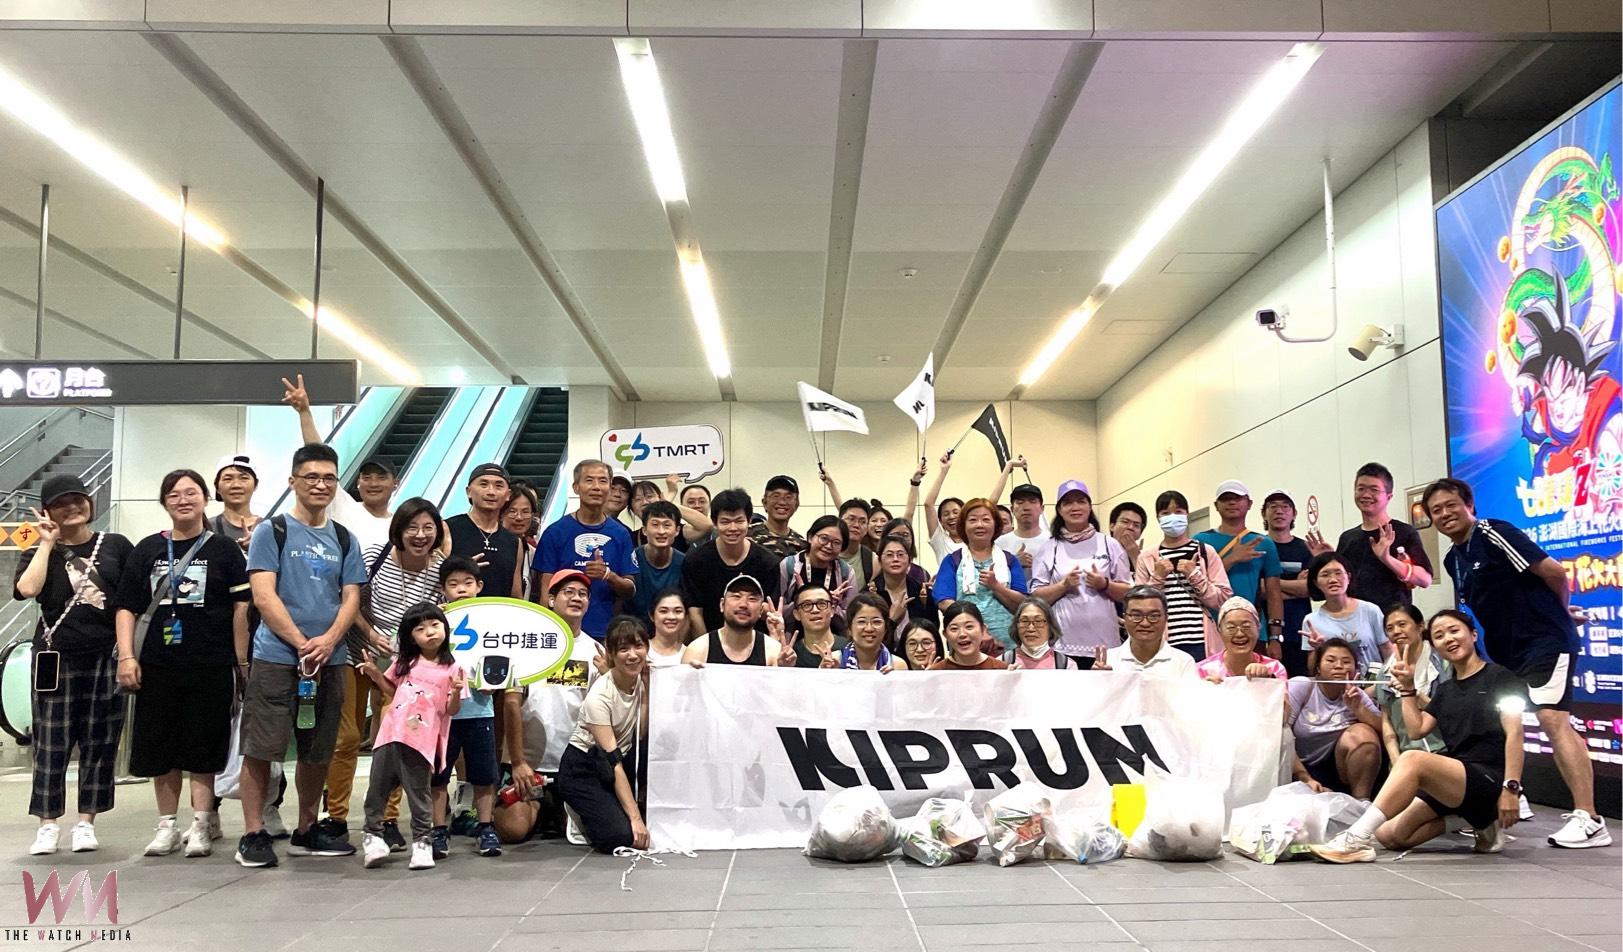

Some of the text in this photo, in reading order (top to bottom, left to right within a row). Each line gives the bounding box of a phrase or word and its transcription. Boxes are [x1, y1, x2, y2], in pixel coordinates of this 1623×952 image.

[64, 367, 106, 387] 月台
[653, 443, 710, 458] TMRT
[483, 631, 558, 649] 台中捷運
[776, 725, 1172, 791] KIPRUM
